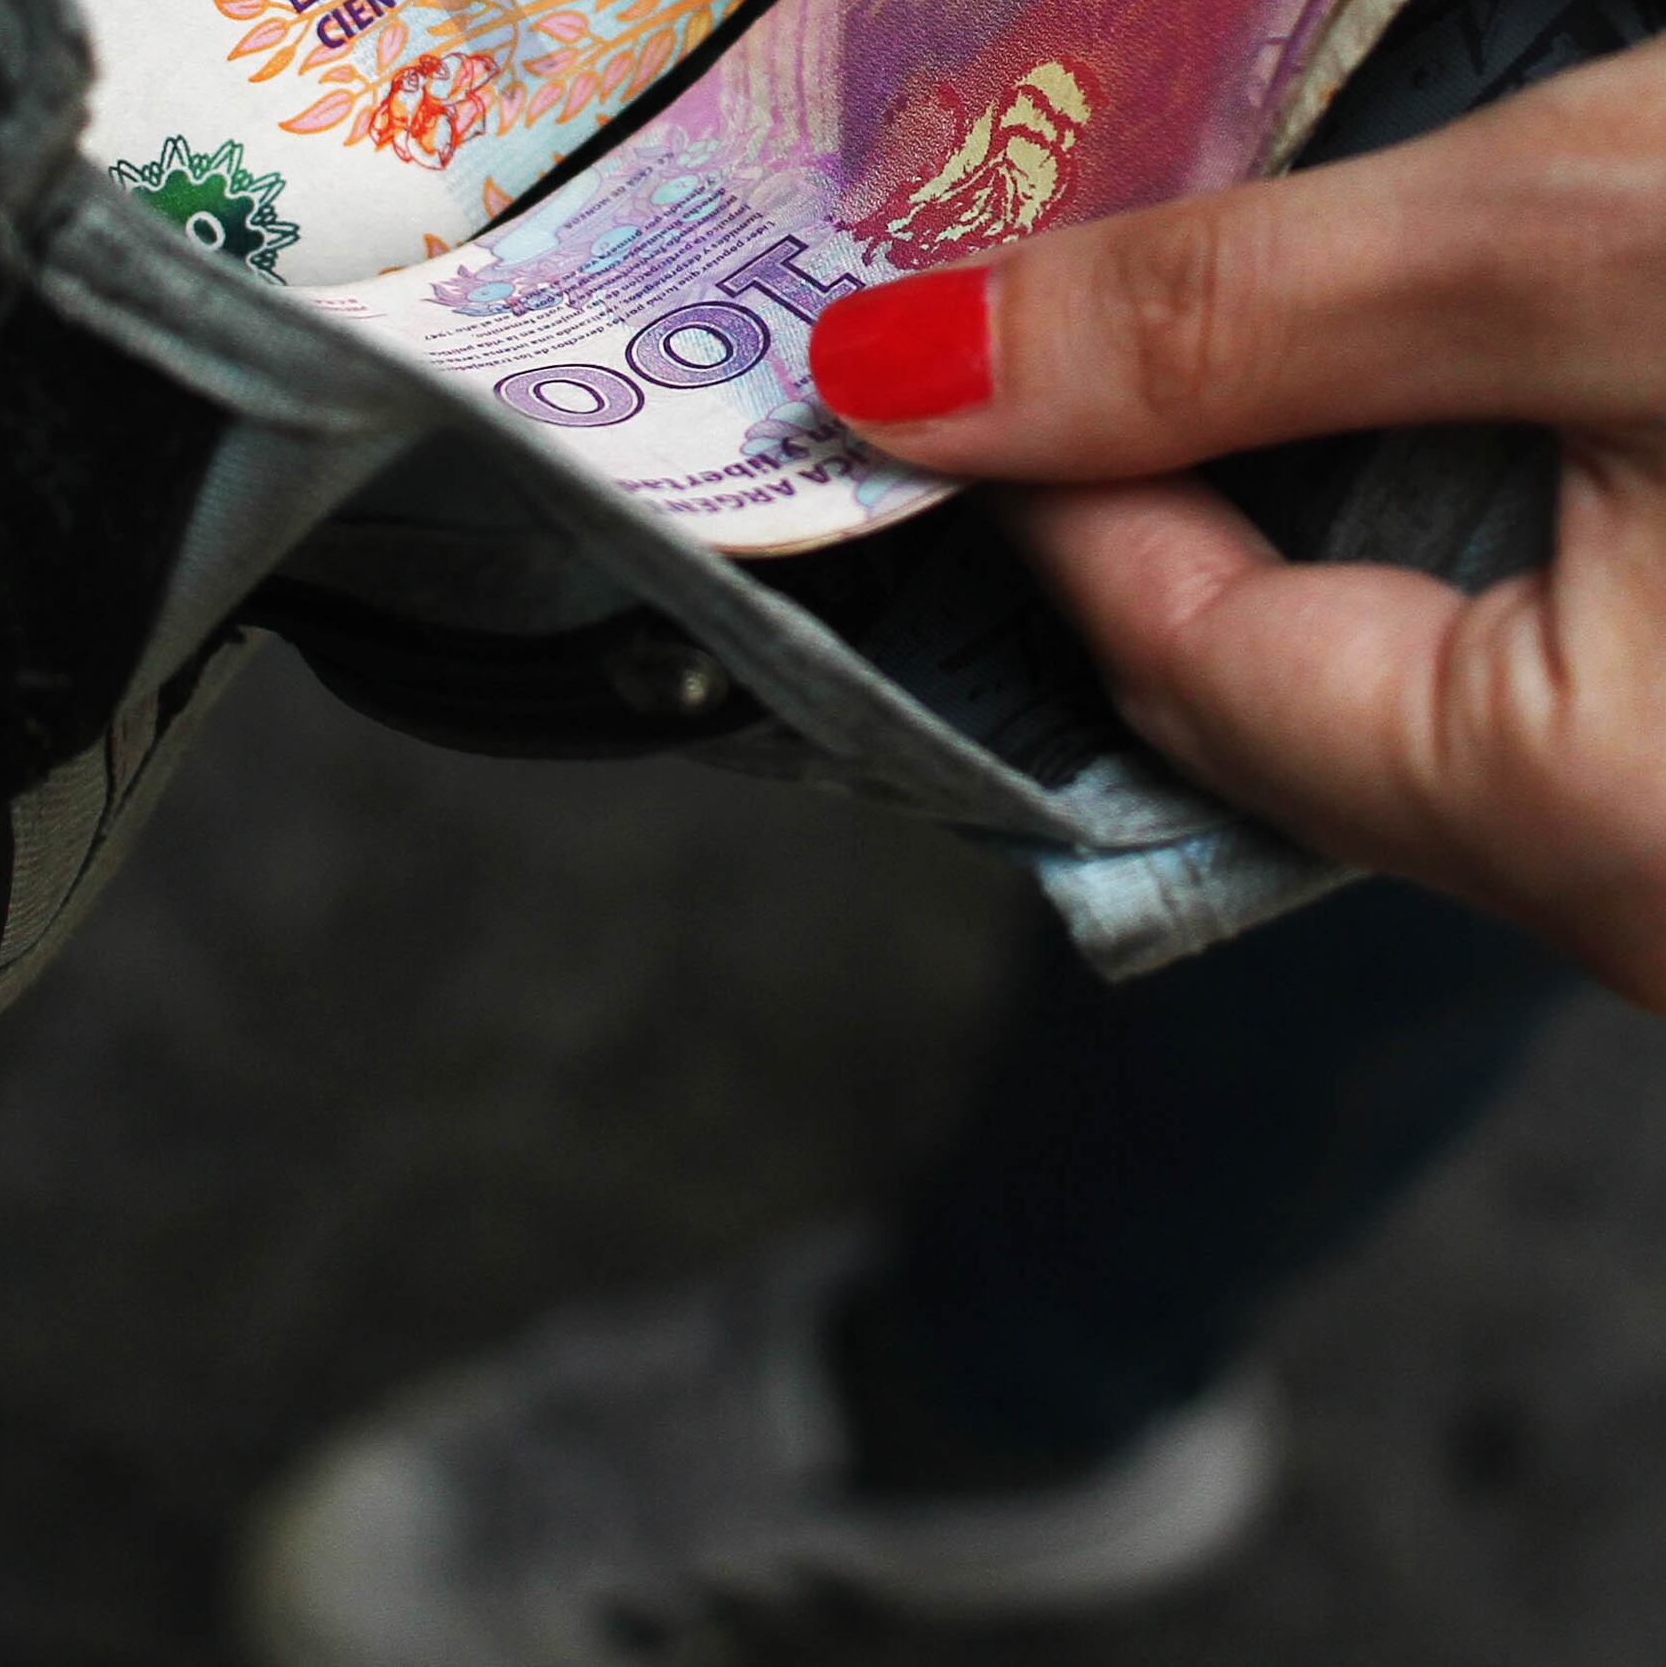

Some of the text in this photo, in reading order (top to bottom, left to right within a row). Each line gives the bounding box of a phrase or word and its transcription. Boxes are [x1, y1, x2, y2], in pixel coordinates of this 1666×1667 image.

[711, 212, 764, 249] humildes
[702, 240, 745, 273] popular
[678, 270, 701, 286] que
[625, 304, 645, 319] por
[493, 233, 866, 428] 100
